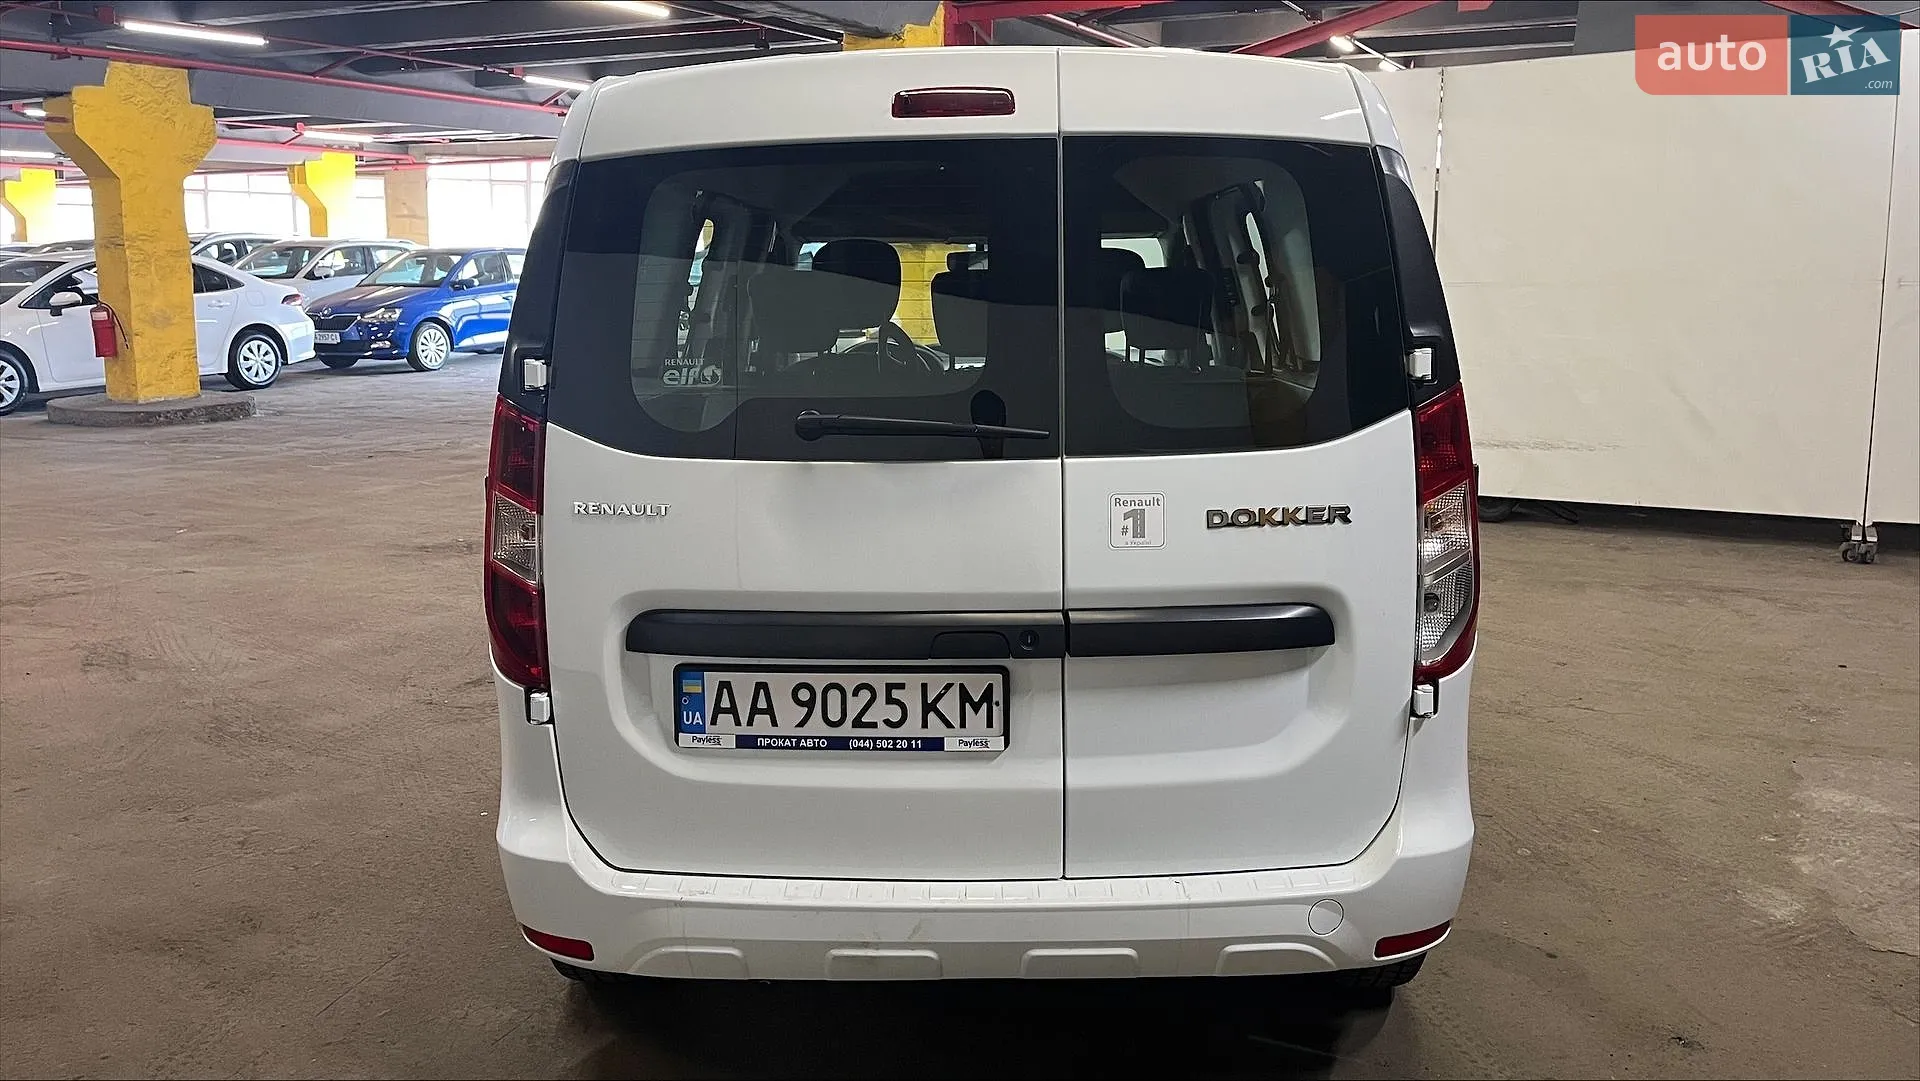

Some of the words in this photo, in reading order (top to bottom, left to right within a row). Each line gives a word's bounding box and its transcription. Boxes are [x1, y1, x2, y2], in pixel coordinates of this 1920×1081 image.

[664, 358, 705, 366] RENAULT
[663, 367, 701, 385] elf
[1114, 496, 1161, 507] Renault
[573, 501, 672, 516] RENAULT
[1206, 504, 1353, 529] DOKKER
[709, 680, 779, 727] AA
[791, 681, 909, 729] 9025
[920, 682, 994, 729] KM
[683, 711, 703, 725] UA
[691, 735, 722, 746] Payless
[757, 738, 797, 747] ПРОКАТ
[800, 738, 828, 748] АВТО
[849, 739, 873, 749] (044)
[876, 739, 893, 749] 502
[896, 739, 908, 749] 20
[911, 739, 922, 749] 11
[958, 738, 990, 748] Payless
